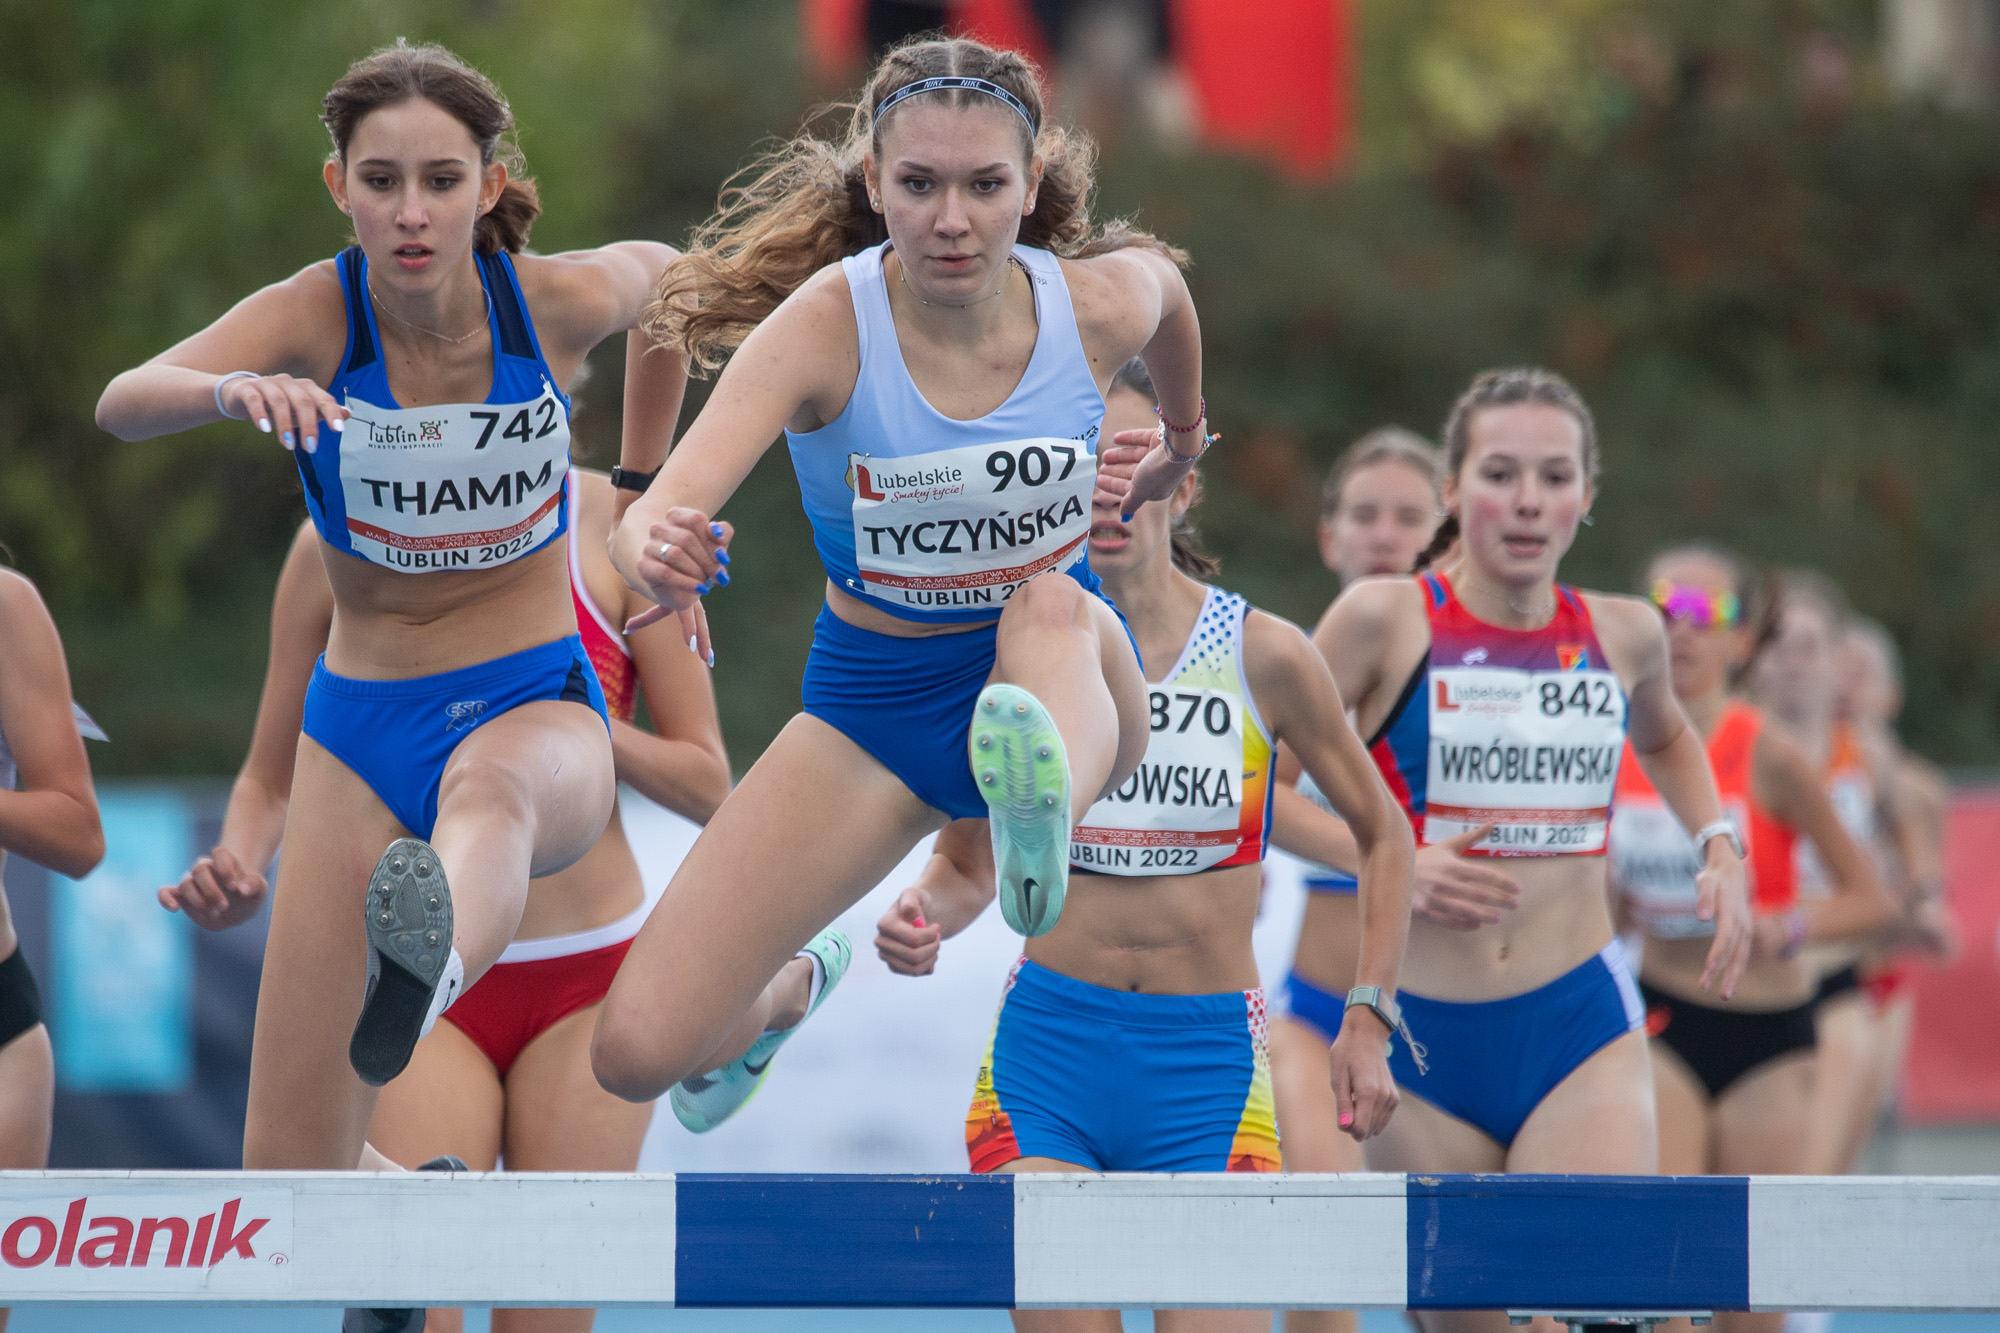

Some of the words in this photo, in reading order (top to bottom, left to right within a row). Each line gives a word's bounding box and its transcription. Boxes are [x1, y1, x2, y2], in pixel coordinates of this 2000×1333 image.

[923, 79, 944, 89] NIKE
[960, 79, 980, 89] NIKE
[994, 87, 1009, 100] NIKE
[368, 421, 417, 443] lublin
[470, 397, 558, 450] 742
[400, 442, 443, 450] INSPIRACJI
[877, 466, 962, 489] lubelskie
[986, 446, 1076, 493] 907
[361, 459, 553, 516] THAMM
[890, 488, 931, 503] Smakuj
[932, 484, 965, 500] życie!
[863, 495, 1084, 555] TYCZYŃSKA
[386, 547, 469, 568] LUBLIN
[479, 531, 533, 563] 2022
[414, 533, 482, 545] MISTRZOSTWA
[442, 538, 486, 549] JANUSZA
[934, 569, 1004, 584] MISTRZOSTWA
[1006, 560, 1038, 576] POLSKI
[963, 575, 1008, 588] JANUSZA
[904, 588, 992, 605] LUBLIN
[1541, 681, 1615, 717] 842
[1149, 692, 1231, 736] 870
[1440, 738, 1614, 784] WRÓBLEWSKA
[1105, 764, 1234, 808] OWSKA
[1107, 836, 1149, 847] JANUSZA
[1147, 831, 1177, 840] POLSKI
[1140, 848, 1198, 867] 2022
[0, 1197, 271, 1268] olanik
